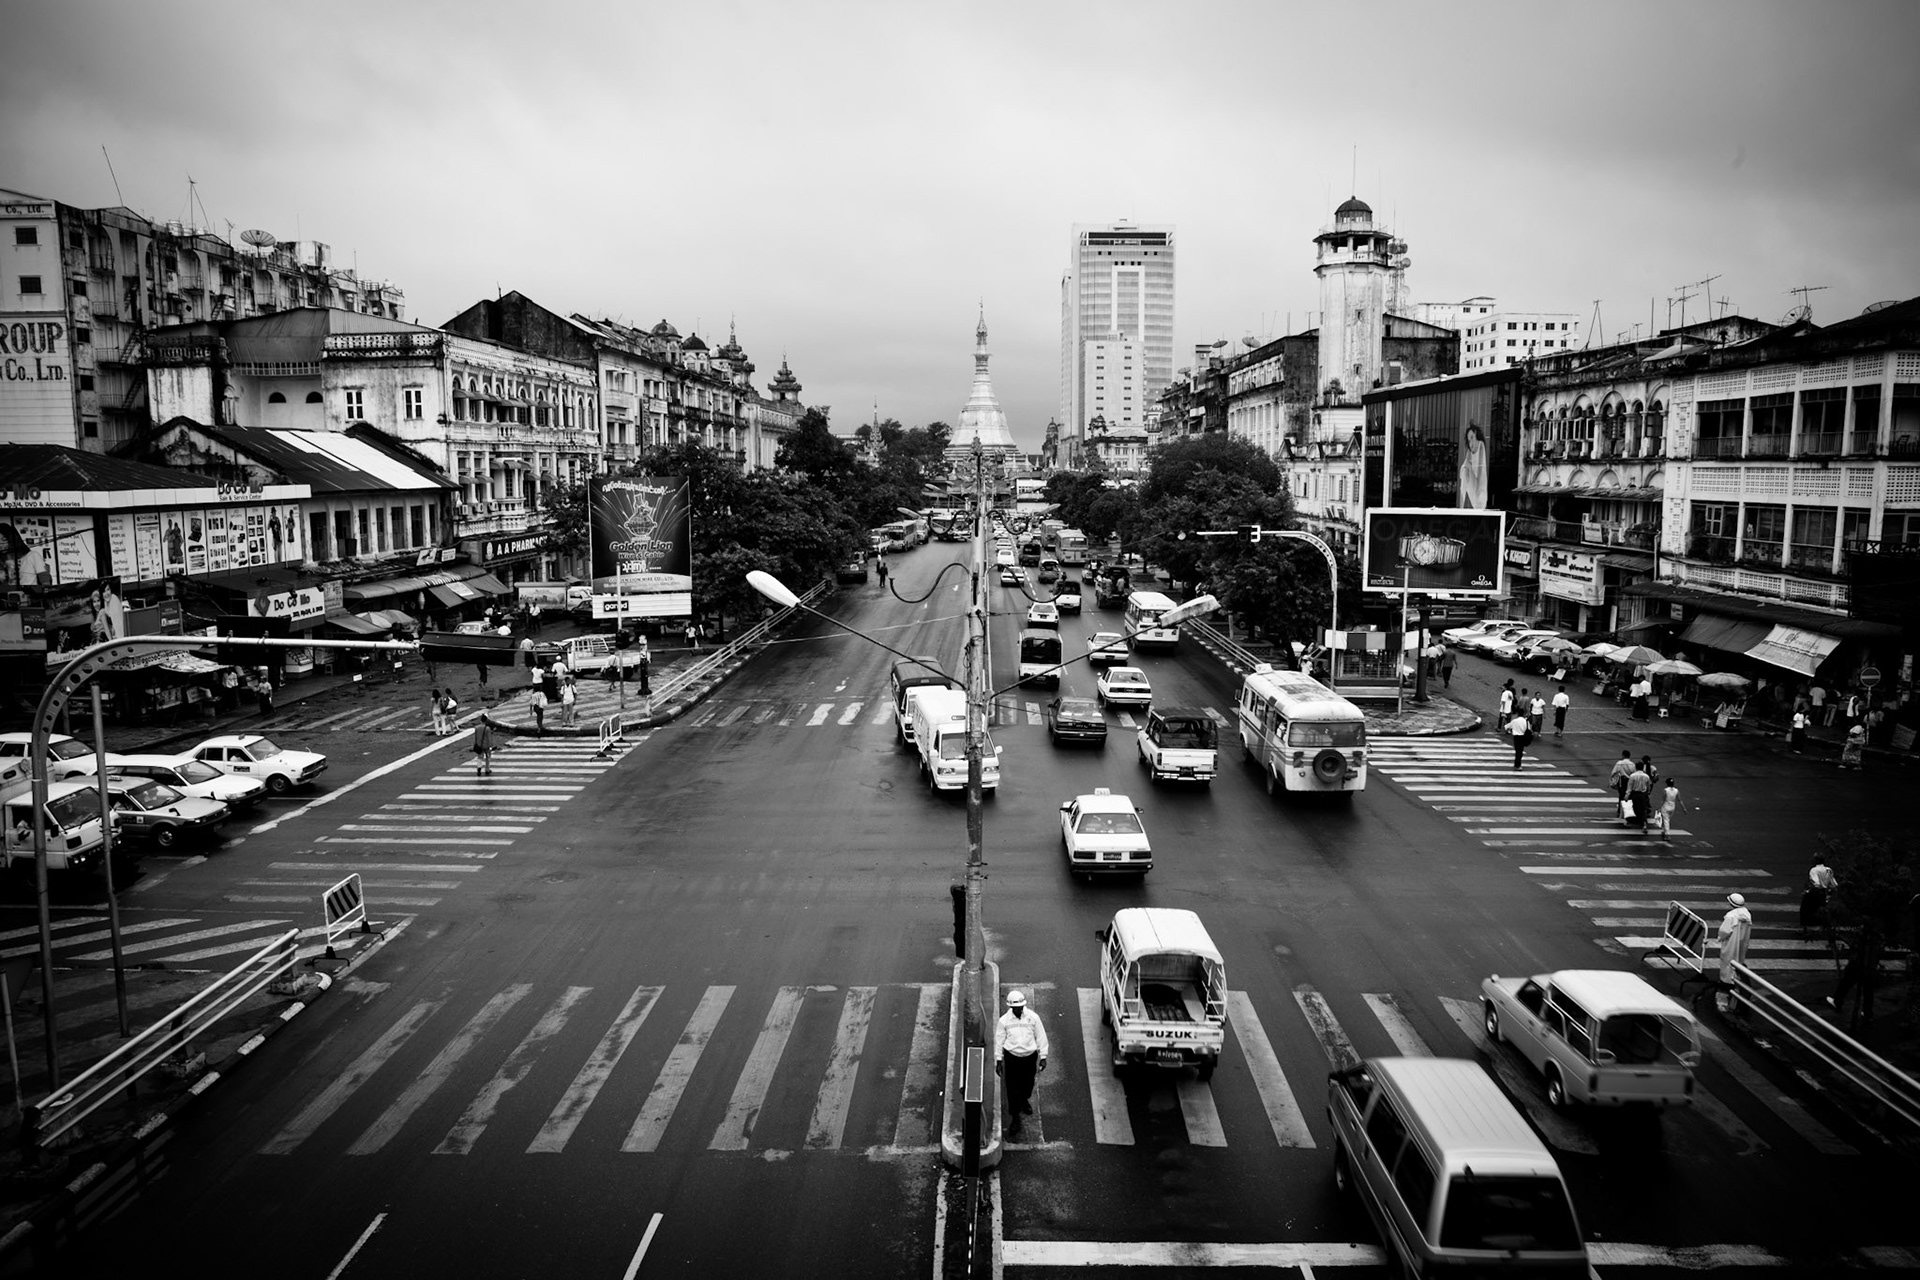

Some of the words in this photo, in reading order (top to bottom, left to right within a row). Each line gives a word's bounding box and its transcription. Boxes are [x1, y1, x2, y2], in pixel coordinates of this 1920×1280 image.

[5, 205, 22, 215] Co.,
[27, 204, 45, 214] Ltd.
[497, 543, 503, 556] A
[504, 542, 510, 555] A
[610, 541, 649, 552] Golden
[650, 540, 674, 553] Lion
[274, 599, 285, 611] Do
